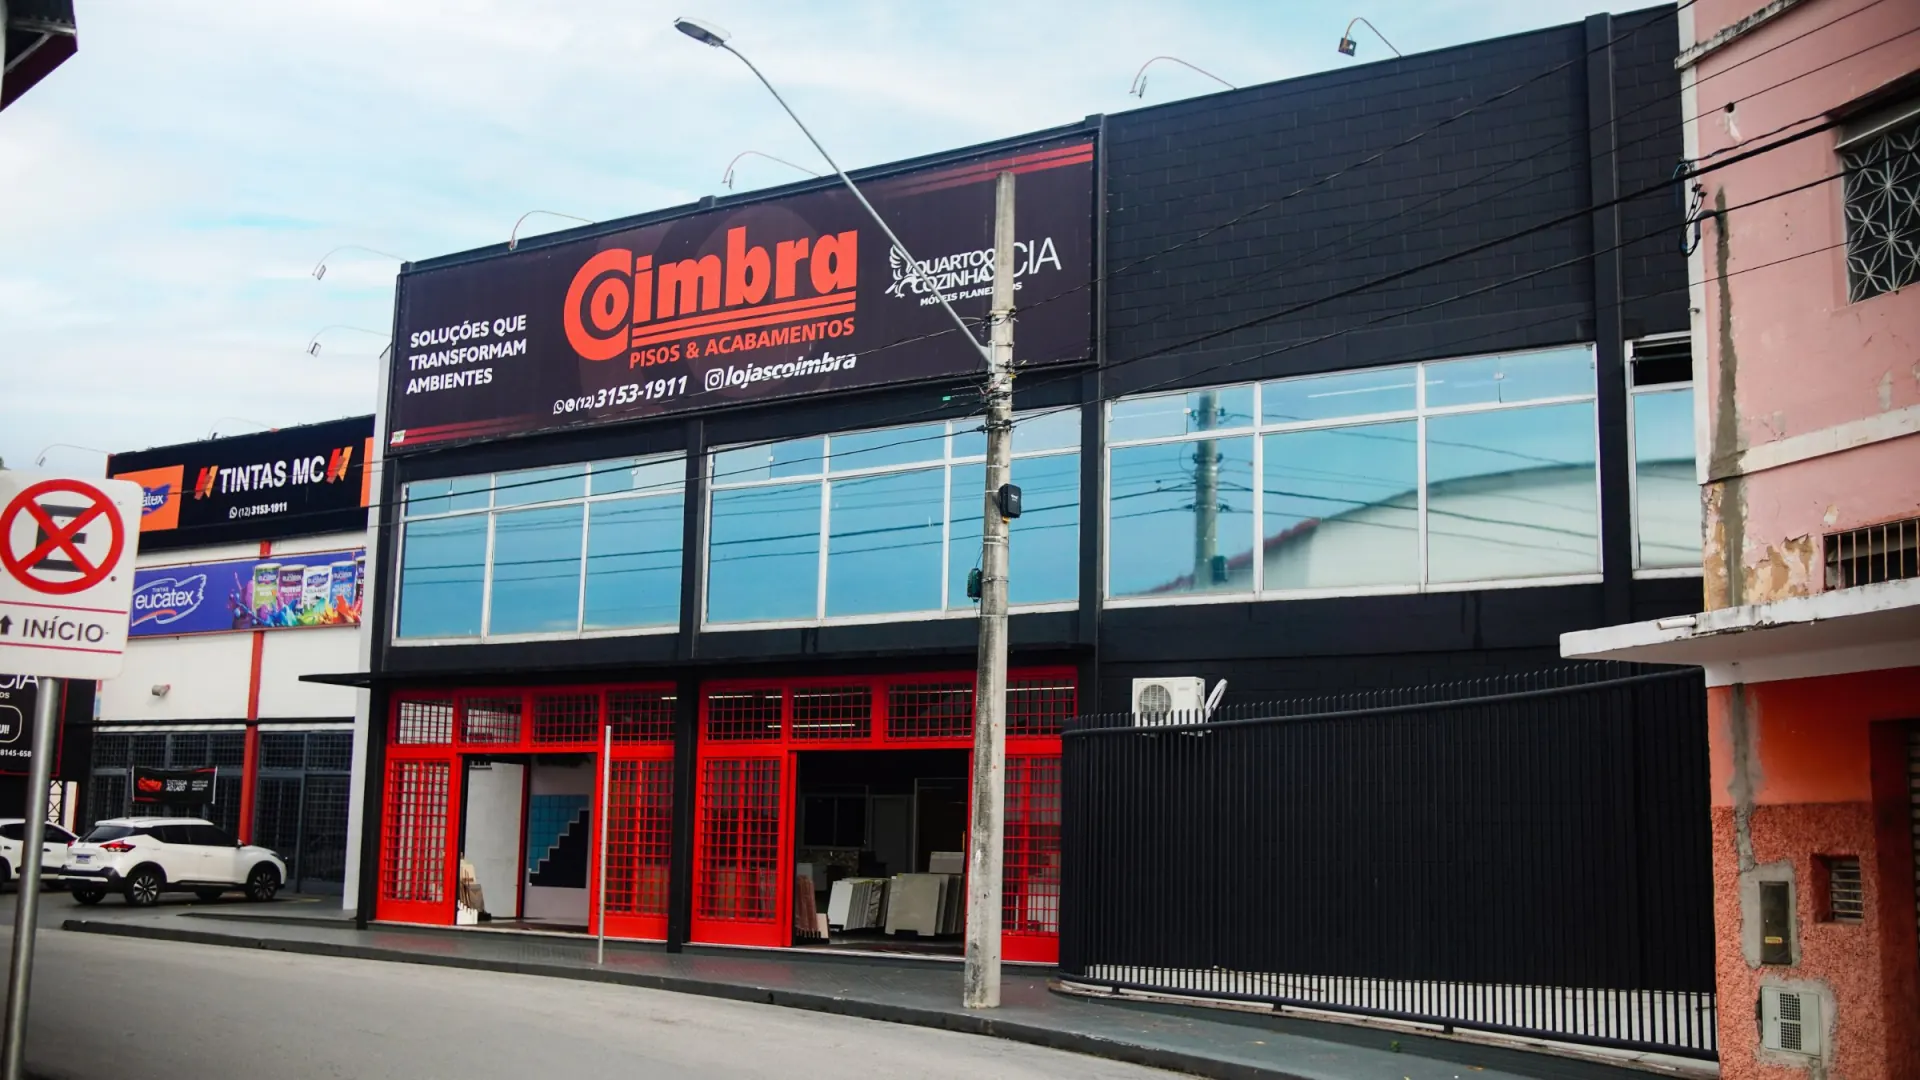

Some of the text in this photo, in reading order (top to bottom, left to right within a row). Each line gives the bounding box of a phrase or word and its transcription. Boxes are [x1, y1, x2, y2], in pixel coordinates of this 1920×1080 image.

[911, 266, 990, 294] COZINHA
[912, 250, 984, 277] QUARTO
[563, 226, 858, 361] Coimbra
[410, 314, 527, 348] SOLUÇÕES QUE
[629, 317, 855, 369] PISOS & ACABAMENTOS
[409, 338, 527, 371] TRANSFORMAM
[725, 352, 857, 389] lojascoimbra
[406, 368, 493, 395] AMBIENTES
[220, 455, 325, 494] TINTAS MC
[135, 588, 194, 609] eucatex
[22, 615, 104, 643] INÍCIO
